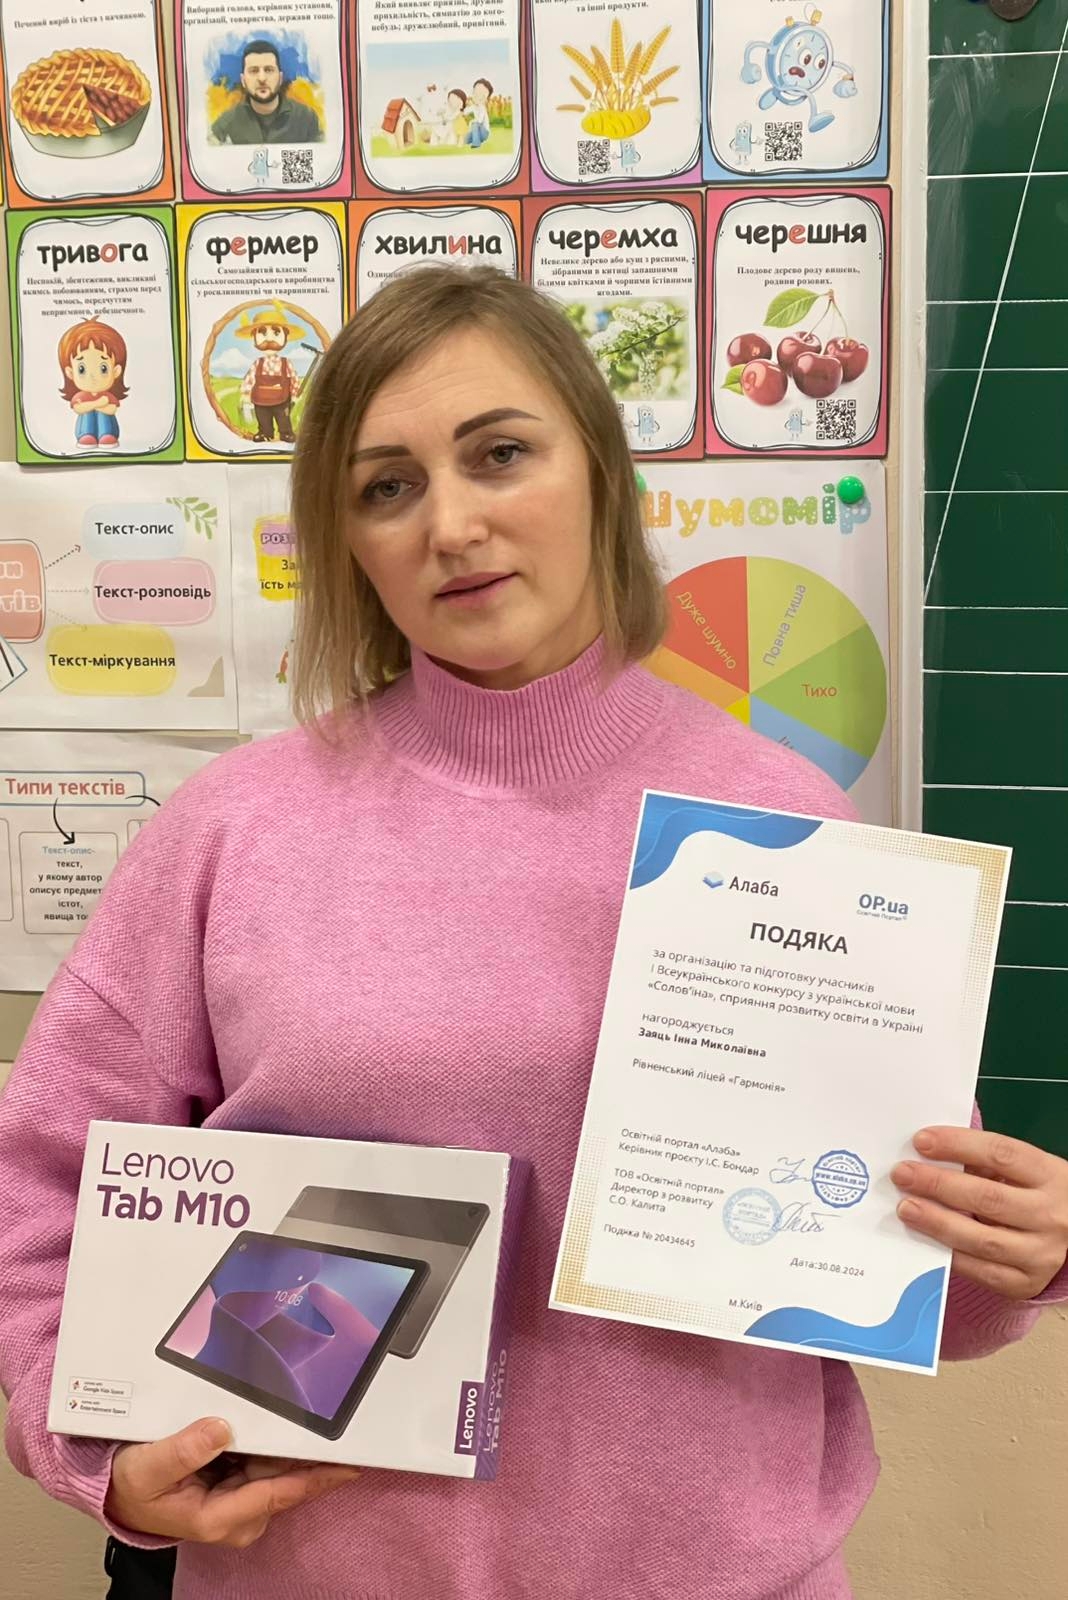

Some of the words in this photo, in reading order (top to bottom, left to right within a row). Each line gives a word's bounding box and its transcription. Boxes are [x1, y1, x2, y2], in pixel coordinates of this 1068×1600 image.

[206, 235, 318, 264] фермер
[375, 235, 502, 255] хвилина
[549, 228, 678, 257] черемха
[736, 222, 866, 253] черешня
[37, 243, 148, 272] тривога
[95, 522, 174, 535] Текст-опис
[94, 585, 211, 600] Текст-розповідь
[676, 592, 706, 625] Дуже
[702, 626, 736, 669] шумно
[763, 622, 791, 666] Повна
[784, 585, 806, 618] тиша
[49, 654, 176, 669] Текст-міркування
[801, 684, 837, 697] Тихо
[5, 778, 52, 795] Типи
[58, 778, 125, 795] текстів
[39, 874, 43, 882] у
[46, 874, 73, 882] якому
[76, 875, 102, 883] автор
[64, 888, 102, 896] предмет
[729, 876, 779, 896] Алаба
[859, 894, 908, 914] OP.ua
[750, 922, 848, 954] ПОДЯКА
[653, 950, 665, 958] за
[668, 952, 736, 970] організацію
[740, 964, 752, 972] та
[754, 967, 816, 985] підготовку
[817, 978, 874, 992] учасників
[657, 965, 750, 988] Всеукраїнського
[753, 984, 805, 1000] конкурсу
[815, 994, 881, 1009] української
[884, 1004, 914, 1015] мови
[642, 1014, 733, 1034] нагороджується
[719, 994, 775, 1008] сприяння
[778, 1004, 830, 1020] розвитку
[833, 1012, 869, 1024] освіти
[872, 1018, 878, 1026] в
[882, 1019, 922, 1032] Україні
[638, 1027, 670, 1040] Заяць
[674, 1034, 697, 1045] Інна
[700, 1039, 766, 1056] Миколаївна
[632, 1058, 694, 1076] Рівненський
[696, 1071, 725, 1082] ліцей
[728, 1076, 785, 1091] «Гармонія»
[621, 1128, 661, 1142] Освітній
[664, 1138, 699, 1149] портал
[701, 1144, 740, 1156] «Алаба»
[102, 1143, 234, 1184] Lenovo
[618, 1142, 662, 1156] Керівник
[664, 1152, 704, 1166] проєкту
[722, 1160, 759, 1175] Бондар
[614, 1168, 634, 1179] ТОВ
[636, 1173, 682, 1186] «Освітній
[684, 1182, 724, 1193] портал»
[97, 1184, 162, 1221] Tab
[174, 1190, 250, 1228] M10
[610, 1182, 659, 1198] Директор
[668, 1193, 713, 1208] розвитку
[631, 1199, 666, 1212] Калита
[604, 1224, 639, 1237] Подяка
[654, 1233, 694, 1247] 20434645
[729, 1299, 762, 1311] м.Київ
[460, 1388, 477, 1448] Lenovo
[483, 1362, 498, 1451] Lenovo
